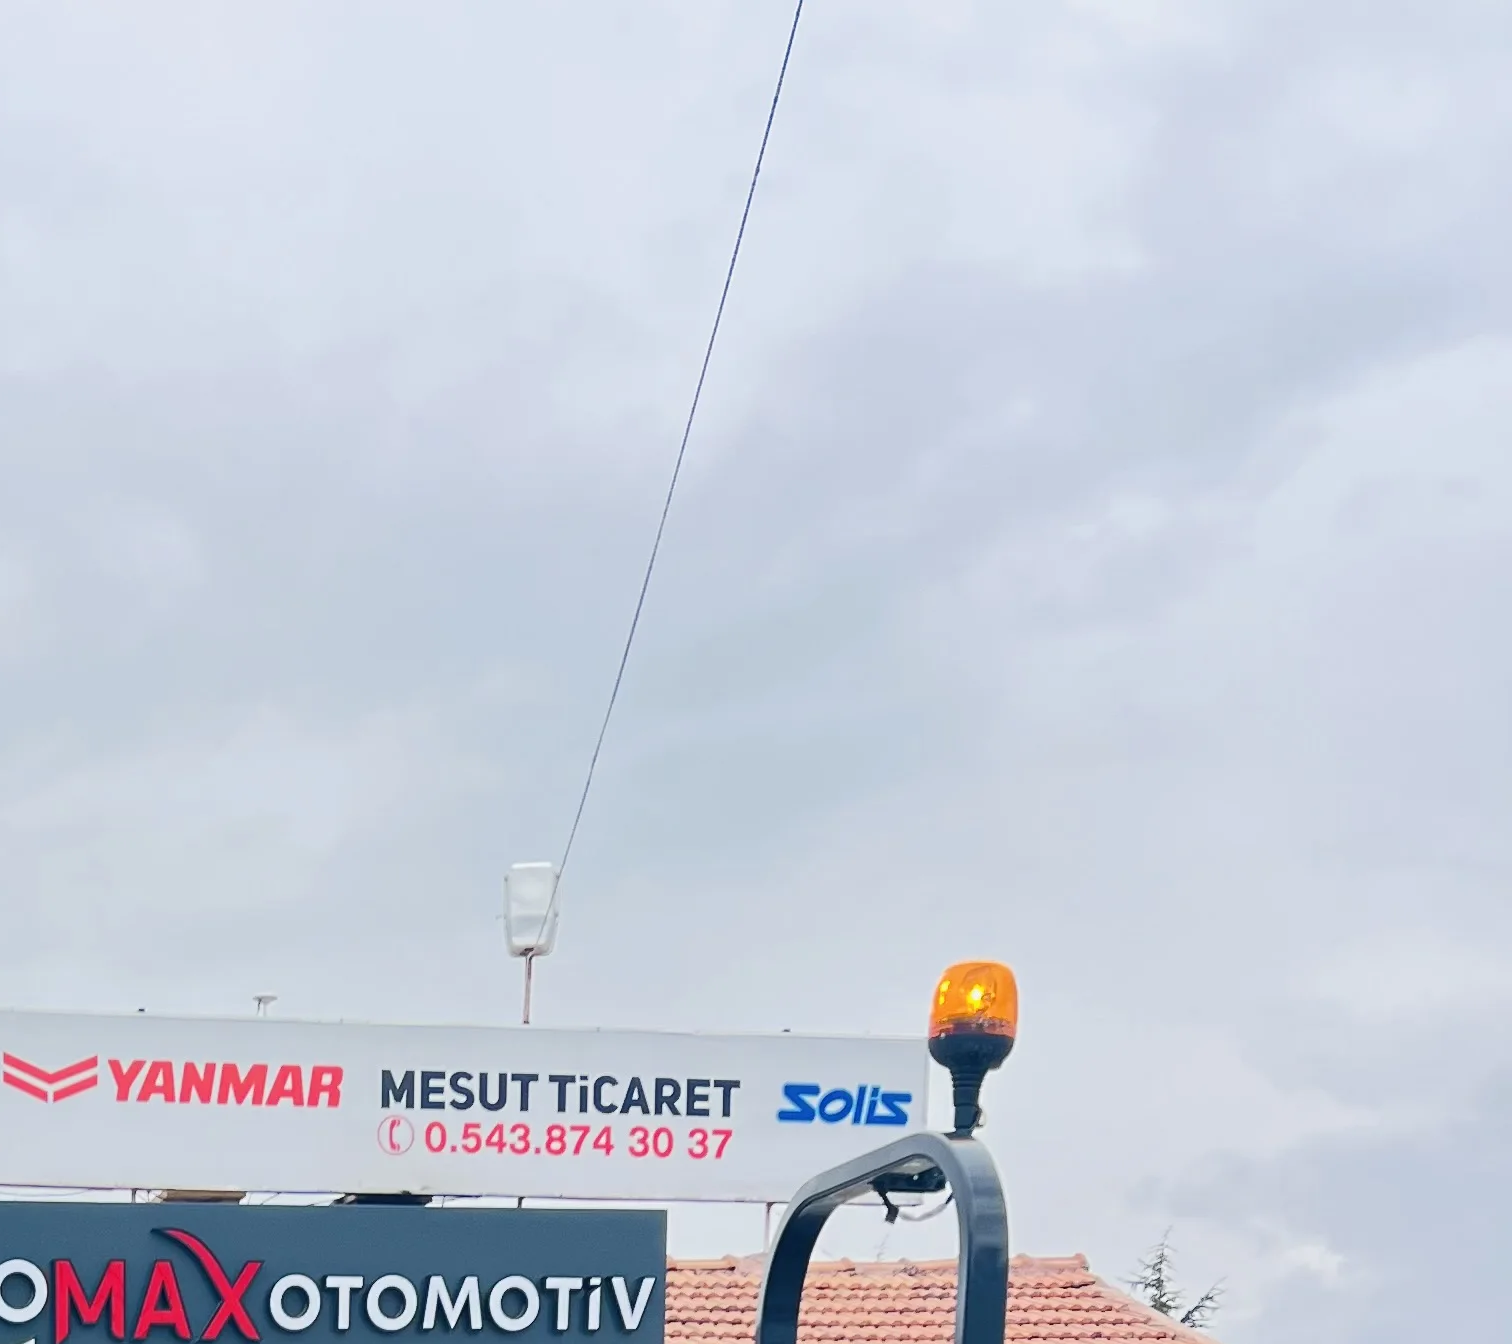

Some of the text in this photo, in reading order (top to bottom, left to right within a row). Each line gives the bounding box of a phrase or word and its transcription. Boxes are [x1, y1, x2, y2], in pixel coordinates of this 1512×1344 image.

[107, 1058, 344, 1108] YANMAR
[381, 1069, 550, 1113] MESUT
[776, 1082, 913, 1127] Solis
[425, 1122, 734, 1160] 0.543.874 30 37
